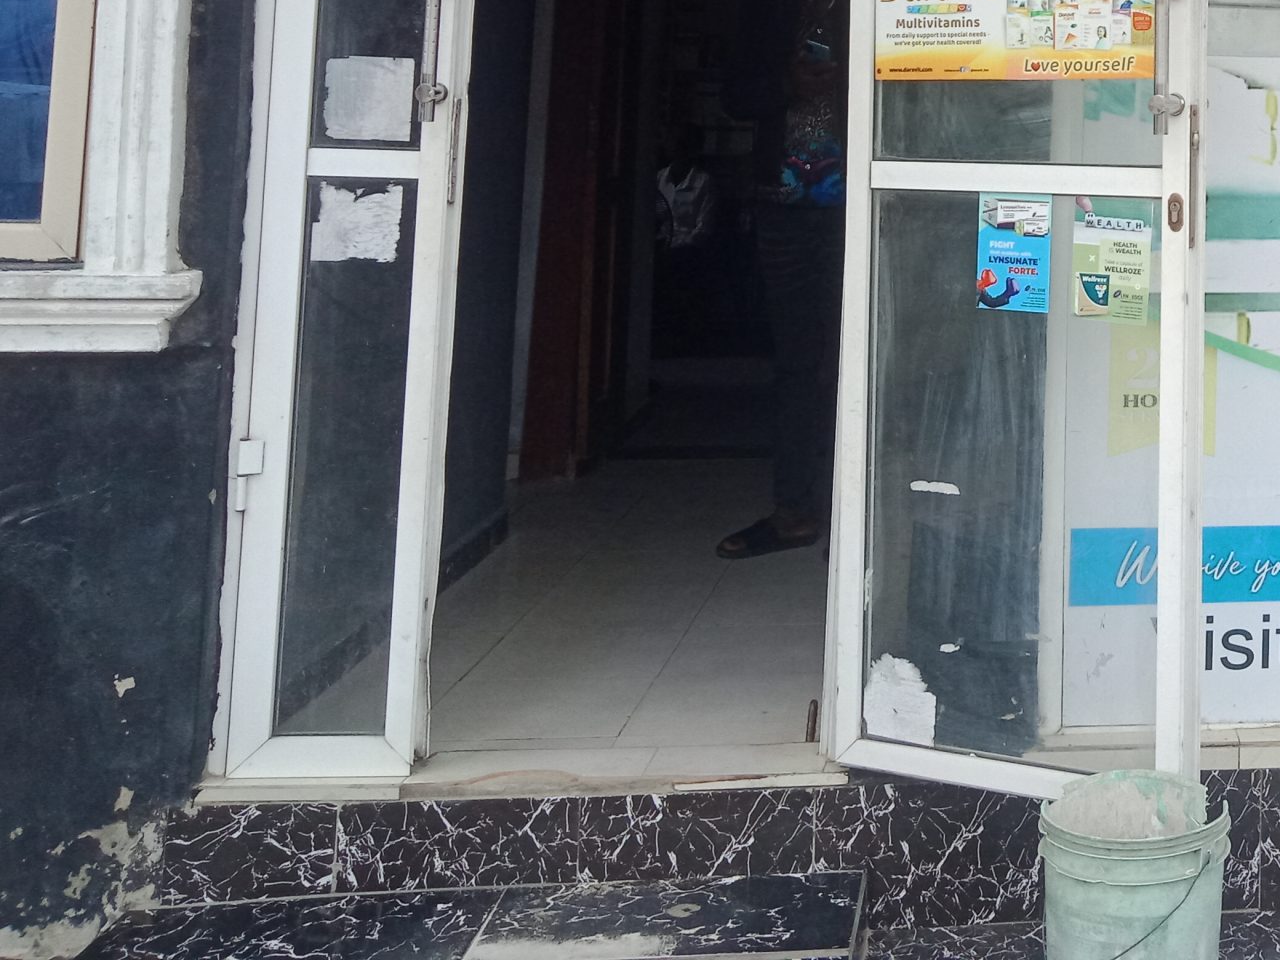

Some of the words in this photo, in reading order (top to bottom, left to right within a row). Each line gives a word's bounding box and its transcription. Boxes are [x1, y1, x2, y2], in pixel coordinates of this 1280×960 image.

[895, 16, 981, 30] Multivitamins
[901, 32, 916, 40] daily
[947, 31, 968, 39] special
[1063, 56, 1136, 75] yourself
[1113, 241, 1138, 249] HEALTH
[988, 255, 1039, 266] LYNSUNATE
[1104, 265, 1142, 275] WELLROZE
[1122, 393, 1160, 409] HO
[1201, 551, 1247, 580] ive
